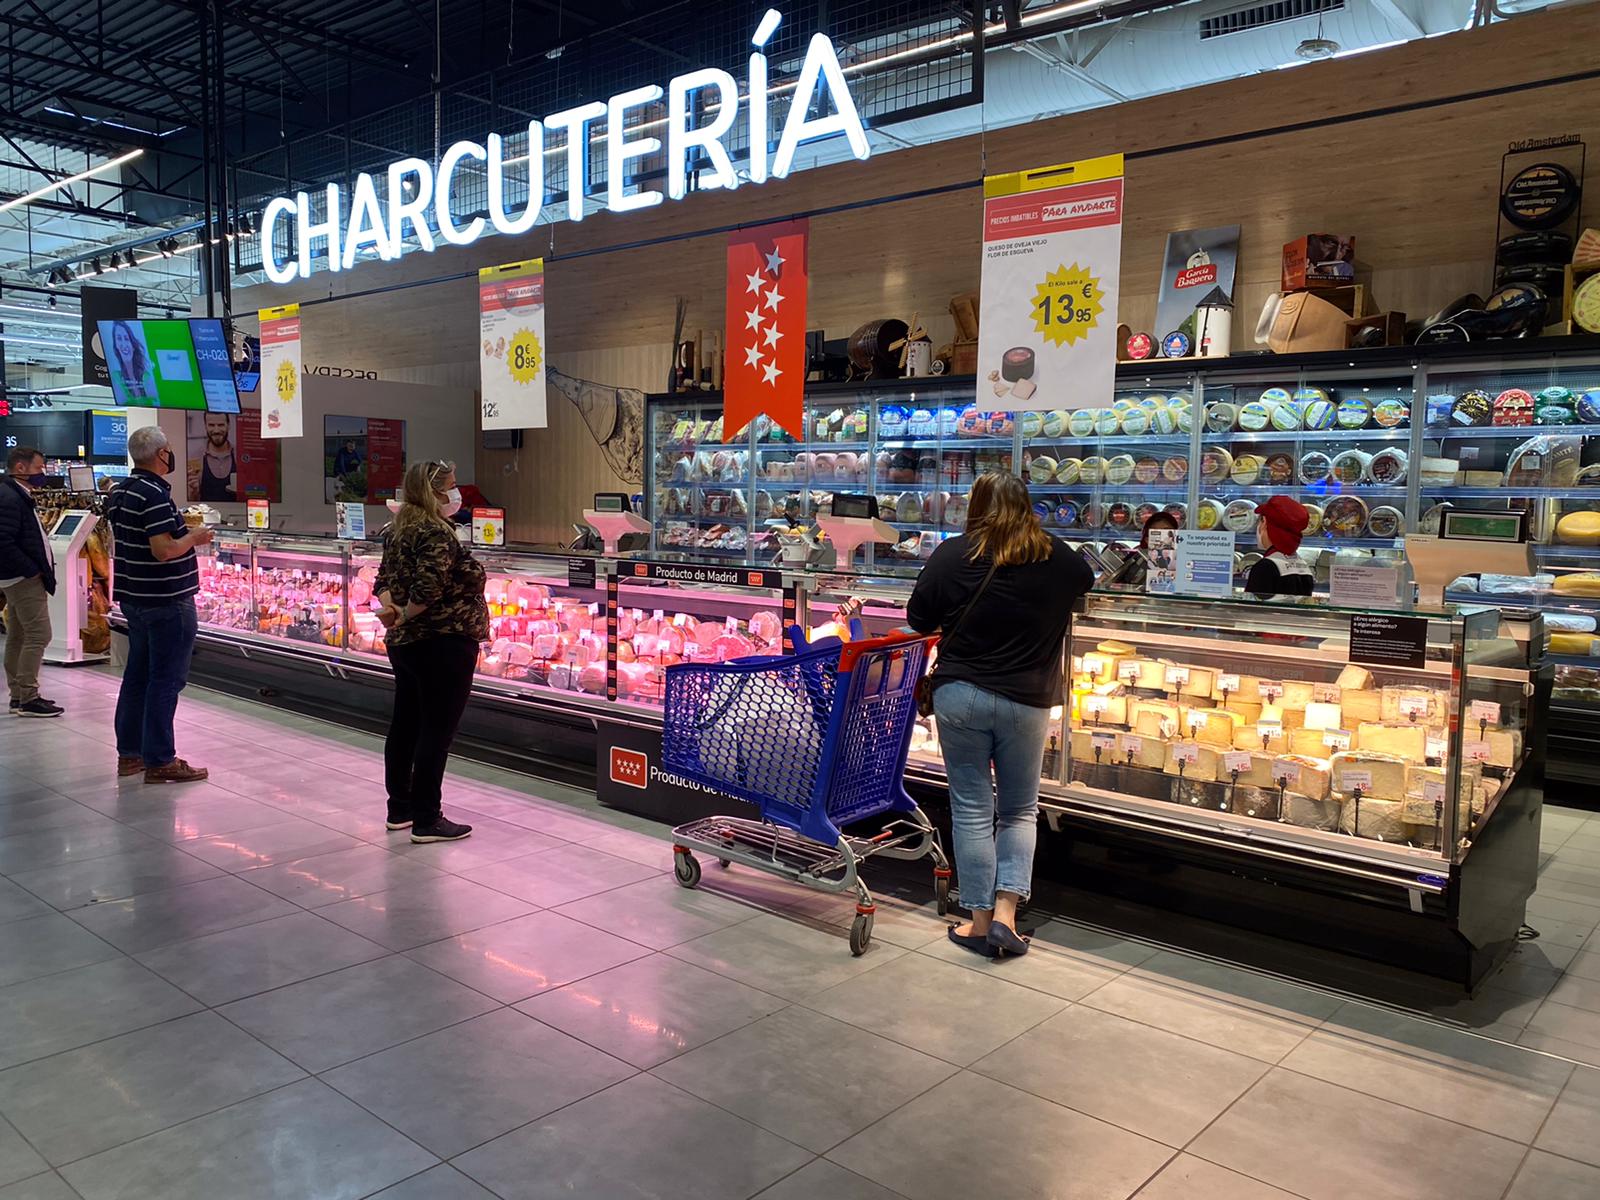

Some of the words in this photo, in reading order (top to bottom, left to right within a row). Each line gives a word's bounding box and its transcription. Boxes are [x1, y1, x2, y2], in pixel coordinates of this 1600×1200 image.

[261, 8, 871, 284] CHARCUTERÍA
[1508, 139, 1526, 151] Old
[1527, 133, 1581, 149] Amsterdam
[1042, 206, 1068, 218] PARA
[1069, 199, 1117, 215] AYUDARTE
[987, 244, 1006, 252] QUESO
[1014, 241, 1032, 249] OVEJA
[1185, 267, 1209, 279] García
[1177, 274, 1214, 288] Baquero
[1082, 283, 1092, 298] €
[1038, 294, 1075, 326] 13
[1076, 308, 1091, 323] 95
[197, 349, 228, 361] CH-020
[525, 343, 531, 354] €
[514, 344, 525, 369] 8
[525, 357, 536, 369] 95
[277, 375, 288, 392] 21
[482, 402, 493, 418] 12
[111, 422, 127, 433] 30
[1194, 534, 1220, 542] seguridad
[655, 565, 693, 581] Producto
[694, 570, 706, 581] de
[707, 570, 738, 583] Madrid
